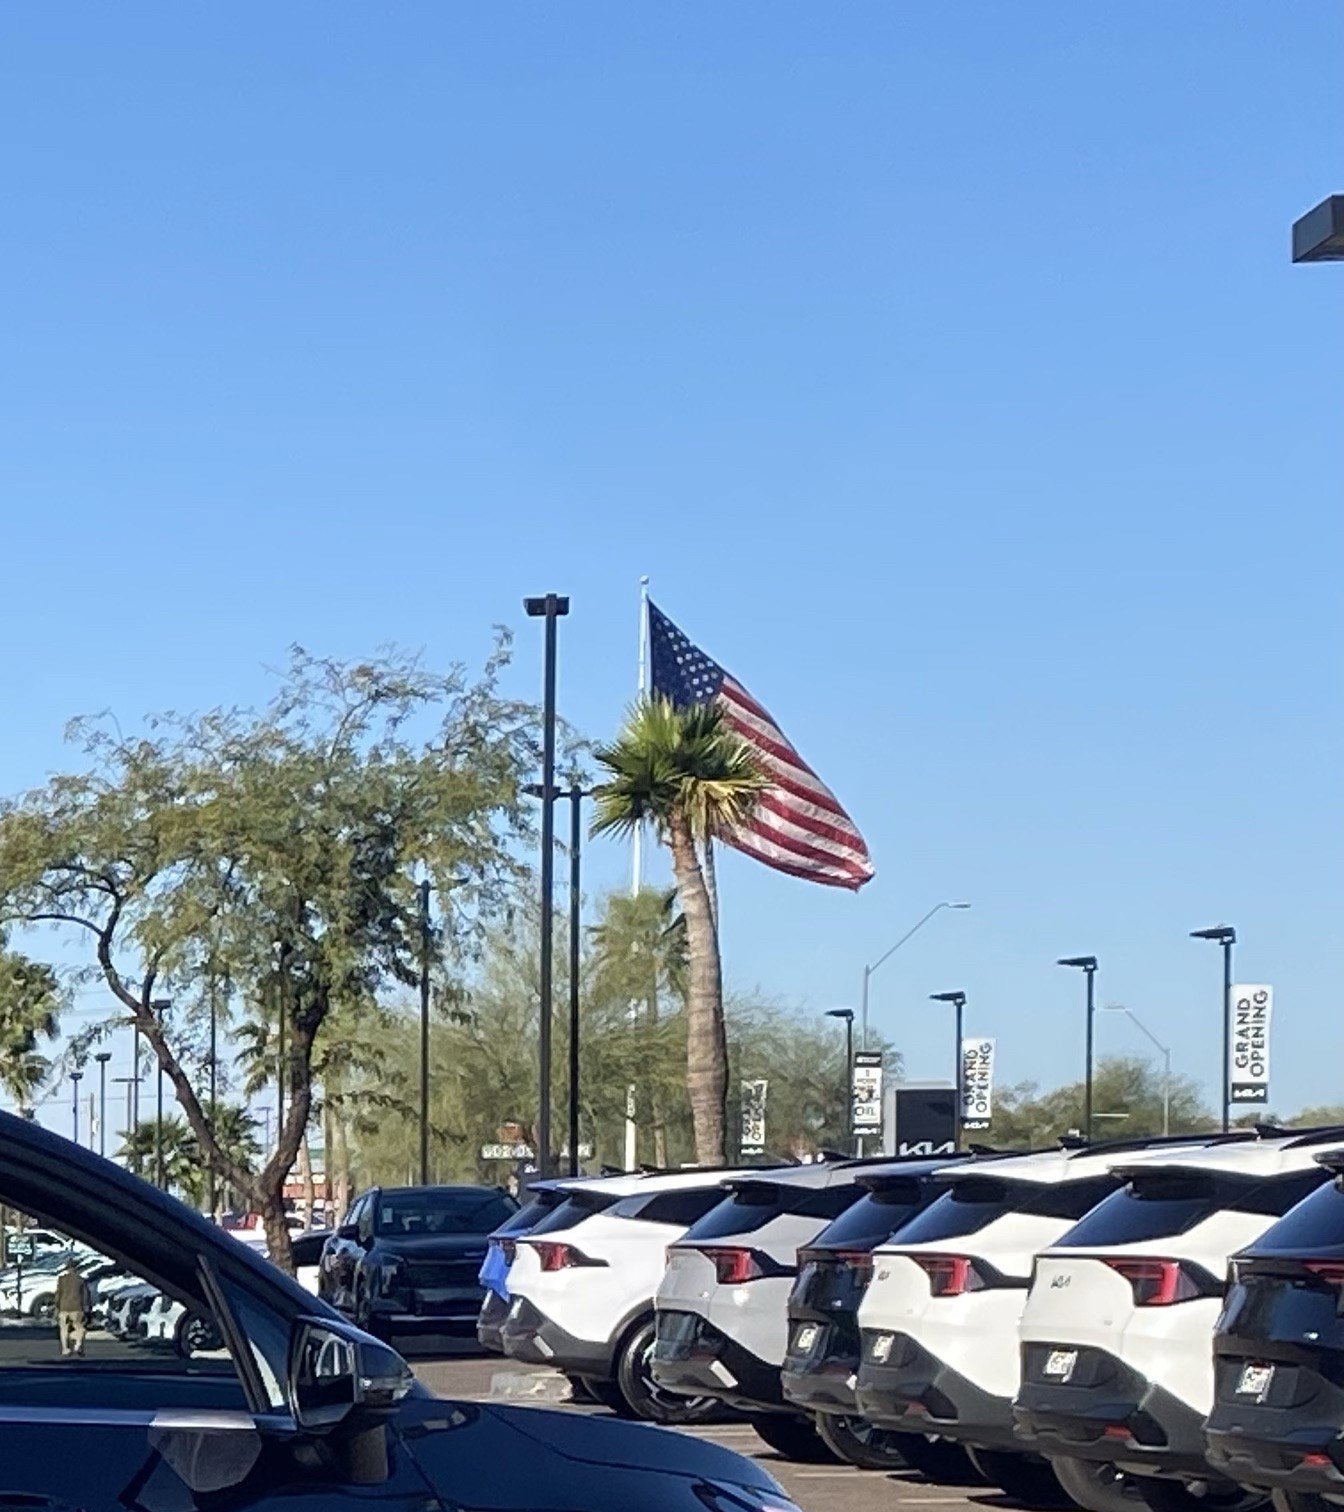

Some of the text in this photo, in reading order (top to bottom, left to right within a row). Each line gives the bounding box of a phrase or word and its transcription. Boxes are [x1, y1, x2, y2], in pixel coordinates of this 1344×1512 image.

[1235, 998, 1251, 1068] GRAND
[1250, 990, 1268, 1077] OPENING
[899, 1141, 955, 1156] KIA
